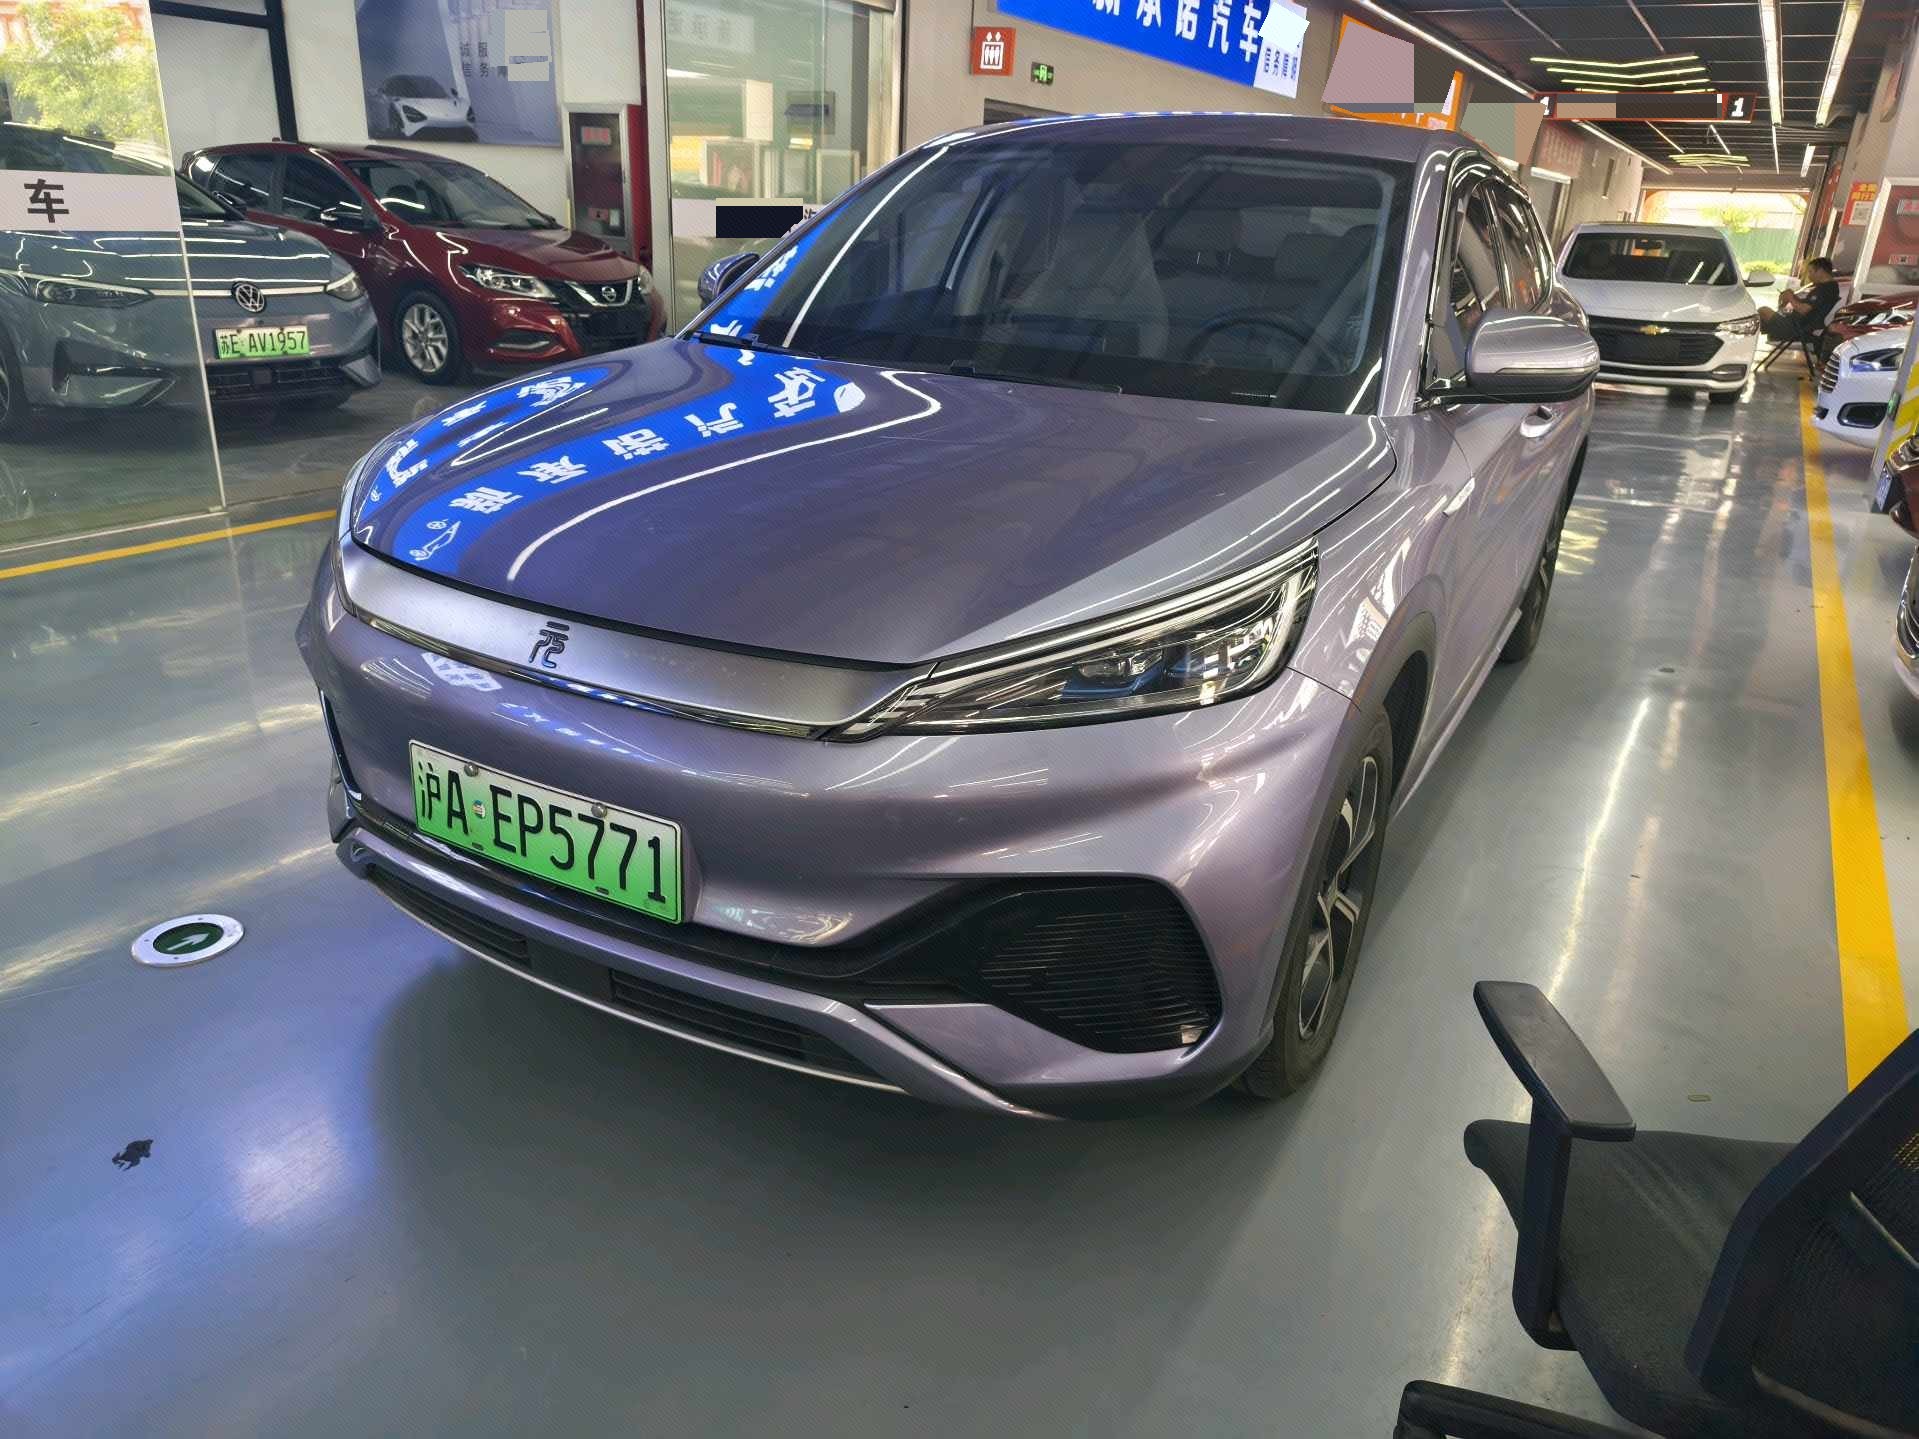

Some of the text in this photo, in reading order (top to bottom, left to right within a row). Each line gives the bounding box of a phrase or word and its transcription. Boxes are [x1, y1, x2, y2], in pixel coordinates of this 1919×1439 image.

[1092, 0, 1262, 62] 诺汽车
[1731, 97, 1744, 117] 1
[24, 178, 69, 223] 车
